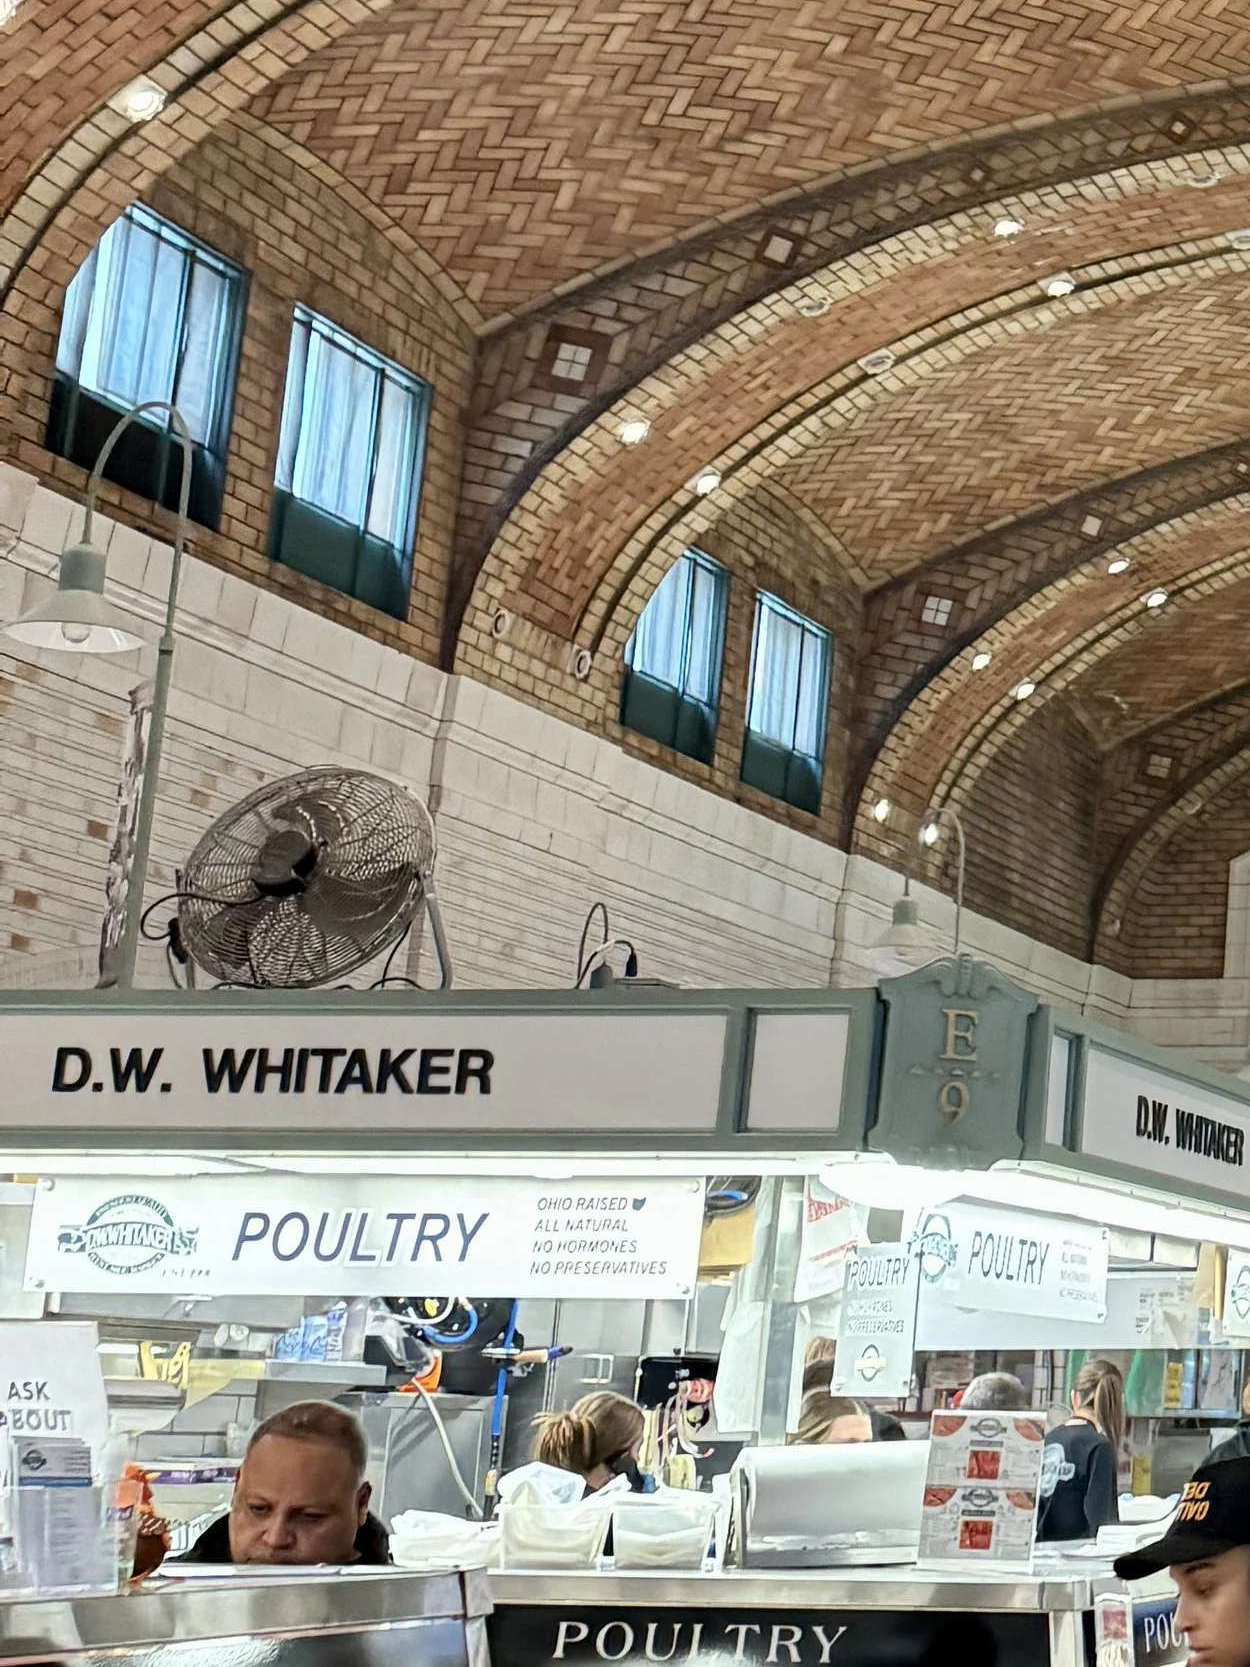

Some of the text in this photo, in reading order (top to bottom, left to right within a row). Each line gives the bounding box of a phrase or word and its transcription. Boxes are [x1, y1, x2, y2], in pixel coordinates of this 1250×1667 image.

[939, 1008, 978, 1062] E
[52, 1047, 495, 1095] D.W. WHITAKER
[939, 1081, 970, 1128] 9
[1136, 1095, 1245, 1166] D.W. WHITAKER
[534, 1218, 629, 1232] ALL NATURAL
[537, 1197, 628, 1211] OHIO RAISED
[232, 1212, 490, 1263] POULTRY
[532, 1240, 637, 1253] NO HORMONES
[968, 1231, 1050, 1285] POULTRY
[530, 1261, 668, 1275] NO PRESERVATIVES
[850, 1257, 911, 1287] POULTRY
[8, 1381, 50, 1401] ASK
[552, 1621, 847, 1664] POULTRY
